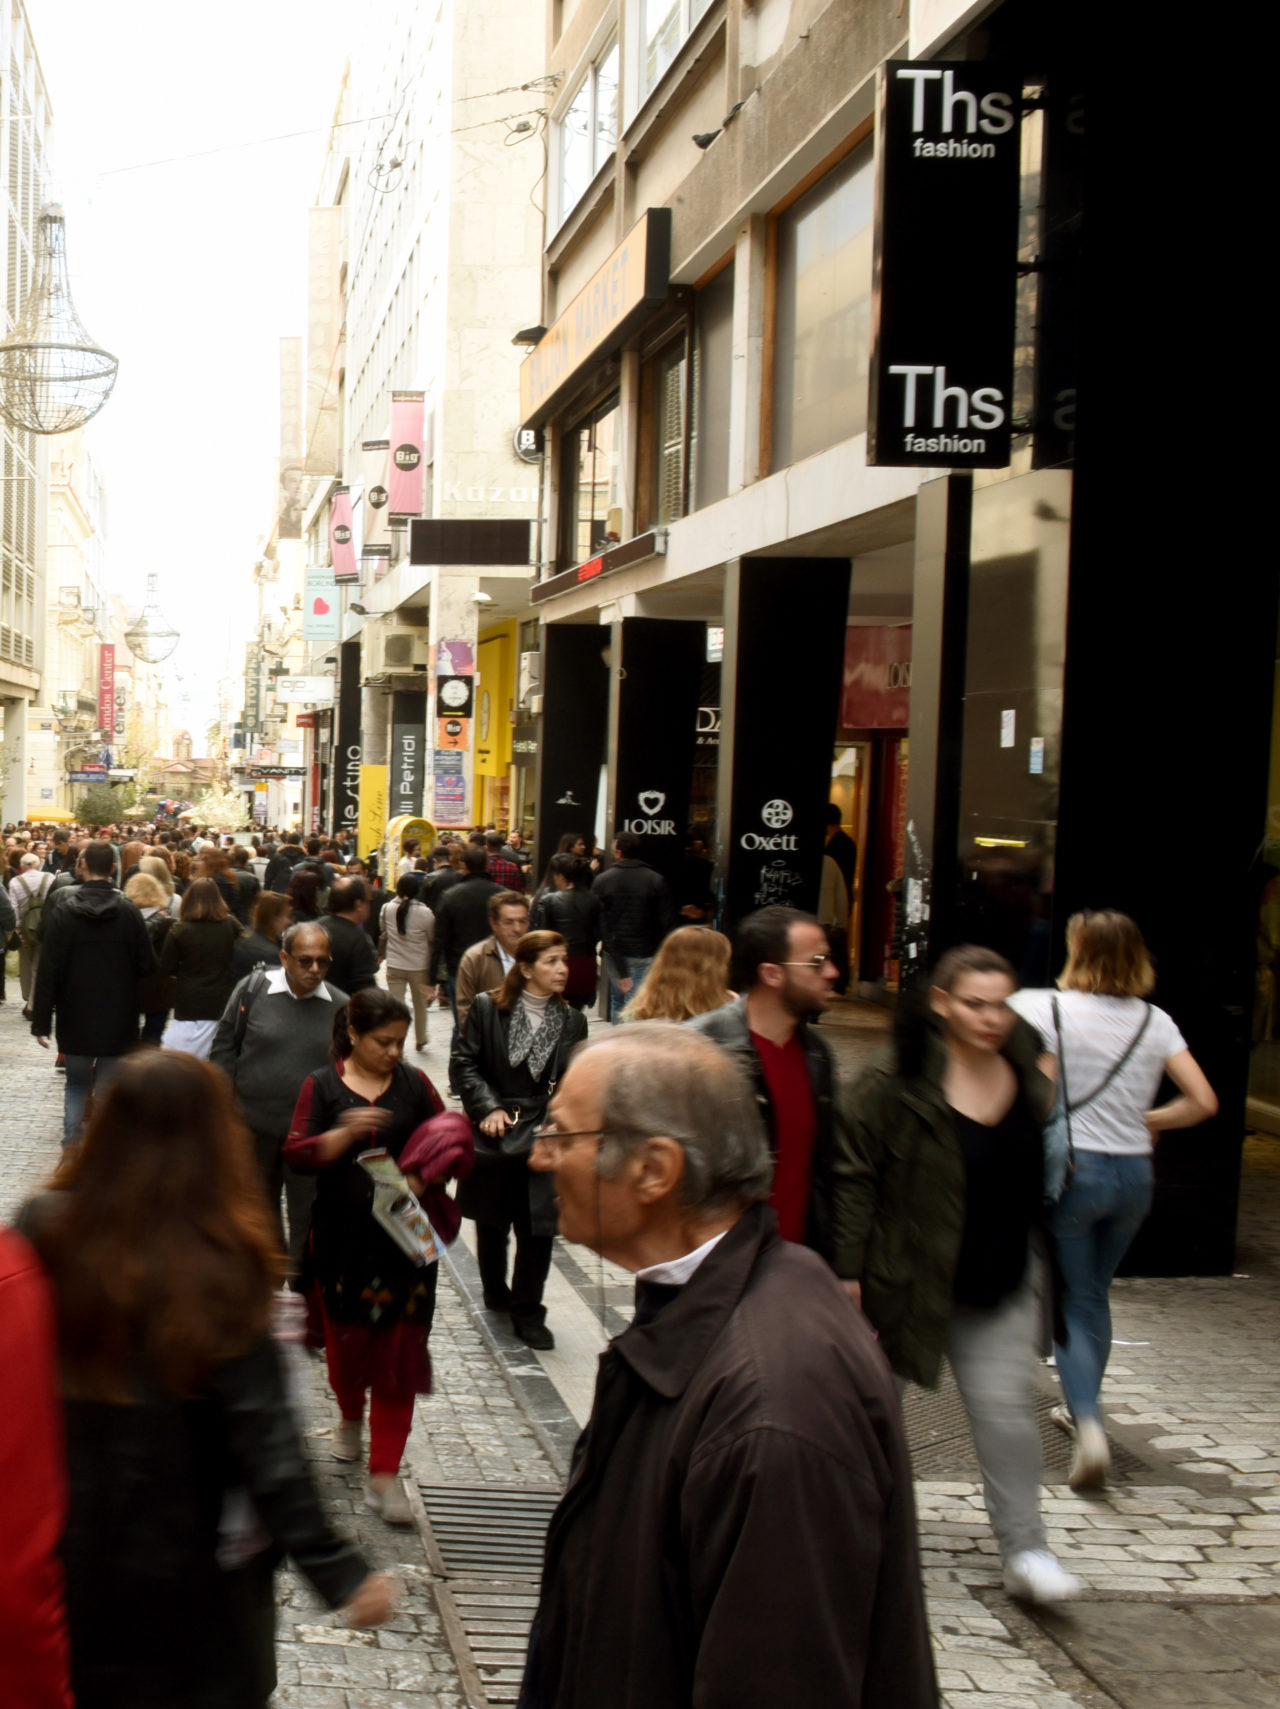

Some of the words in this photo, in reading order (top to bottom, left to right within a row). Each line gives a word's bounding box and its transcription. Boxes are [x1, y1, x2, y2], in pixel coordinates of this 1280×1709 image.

[896, 68, 1015, 136] Ths
[914, 138, 996, 159] fashion
[888, 364, 1006, 431] Ths
[904, 433, 987, 454] fashion
[740, 832, 799, 851] Oxétt
